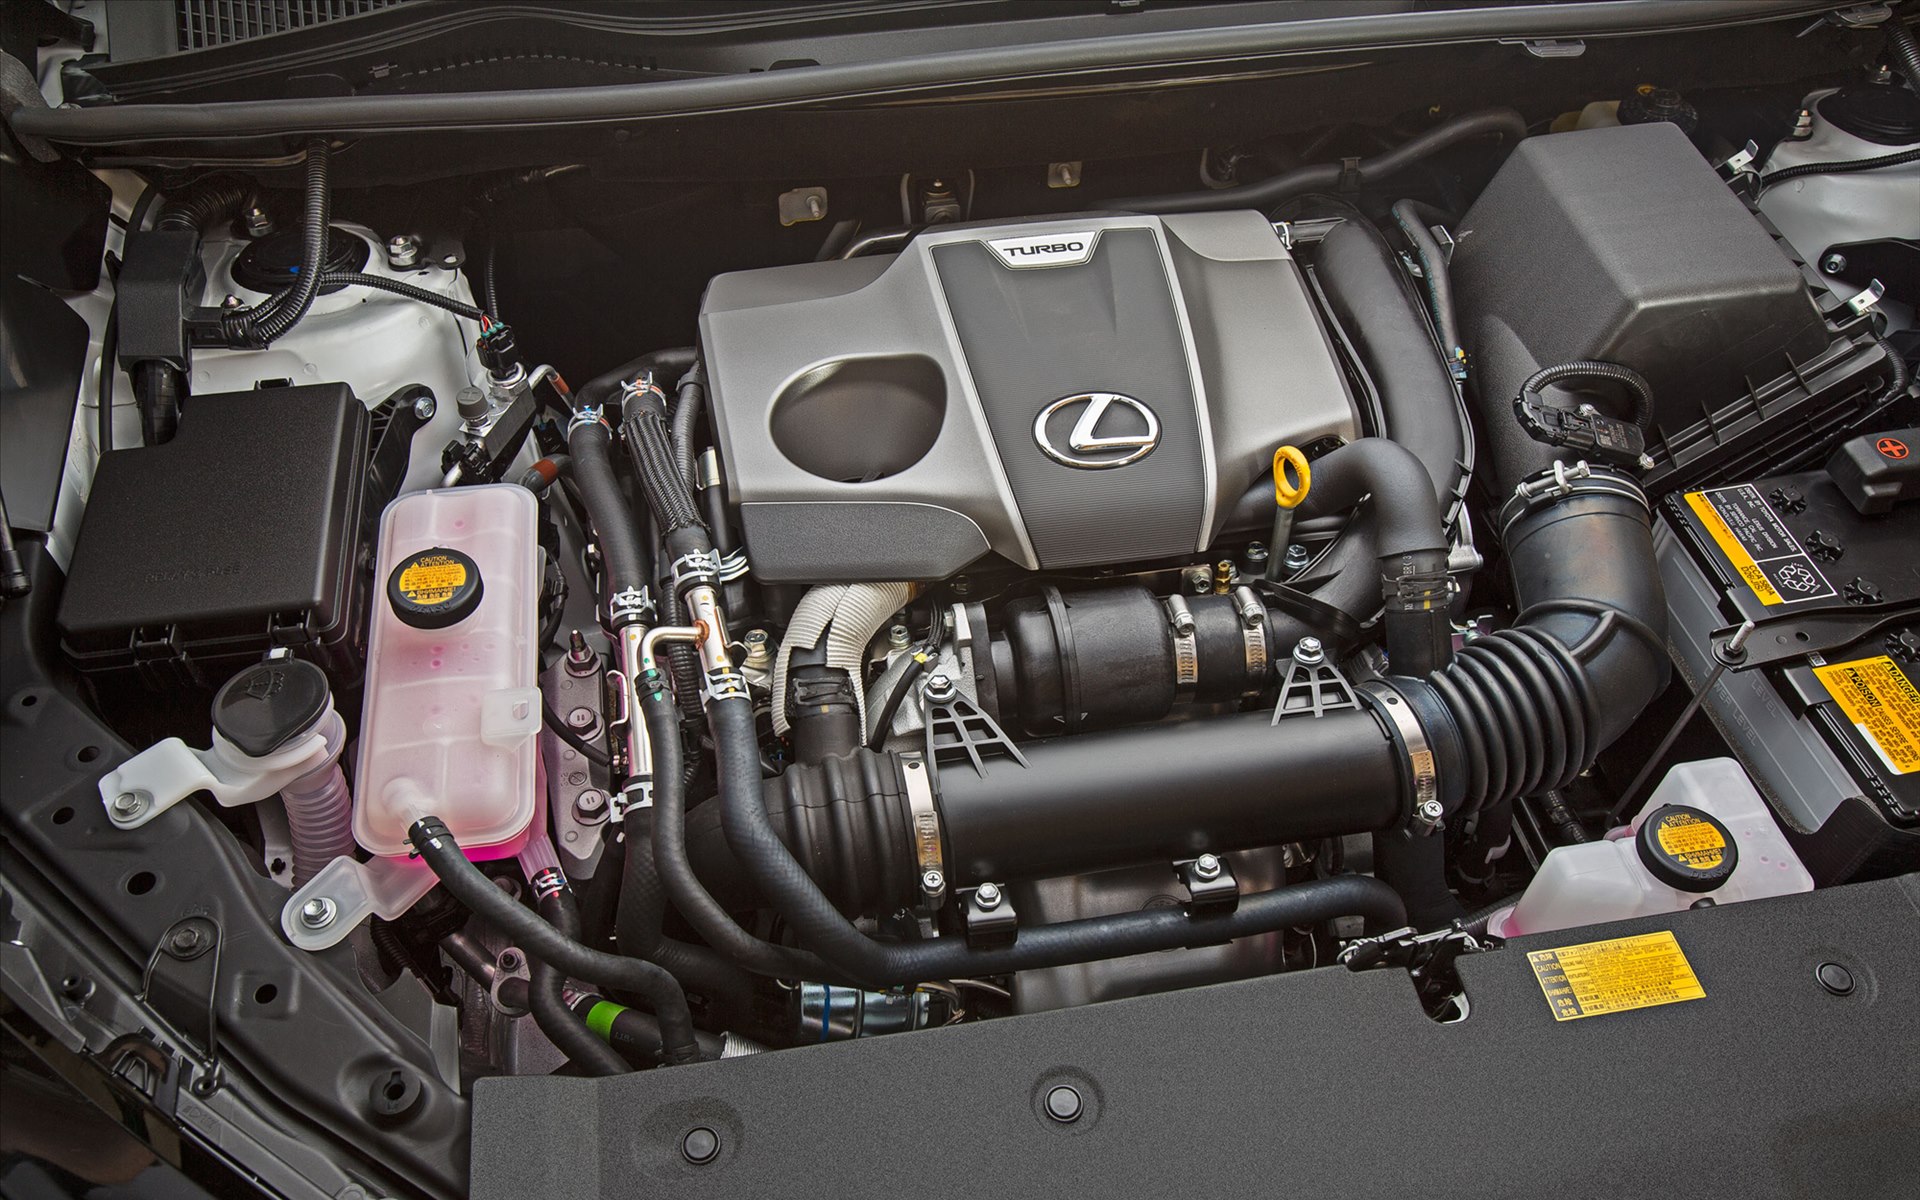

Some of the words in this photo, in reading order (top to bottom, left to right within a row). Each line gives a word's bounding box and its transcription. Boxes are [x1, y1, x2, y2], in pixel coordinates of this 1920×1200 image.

[1003, 241, 1084, 257] TURBO
[1760, 506, 1774, 522] TOYOTA
[1772, 523, 1786, 537] MOTOR
[1743, 528, 1757, 543] PACIFIC
[1752, 518, 1764, 531] LEXUS
[1762, 532, 1777, 548] DIVISION
[420, 555, 448, 563] CAUTION
[1749, 565, 1763, 579] CCA
[1889, 670, 1920, 703] DANGER
[1751, 679, 1778, 718] LEVEL
[1852, 676, 1879, 706] POISON
[1875, 708, 1893, 725] CAUSES
[1890, 726, 1908, 744] SEVERE
[1904, 745, 1920, 760] BURNS
[1732, 707, 1758, 746] LEVEL
[1665, 813, 1691, 822] CAUTION
[1669, 818, 1702, 828] ATTENTION
[1536, 963, 1561, 973] CAUTION
[1542, 975, 1566, 984] ATTENTION
